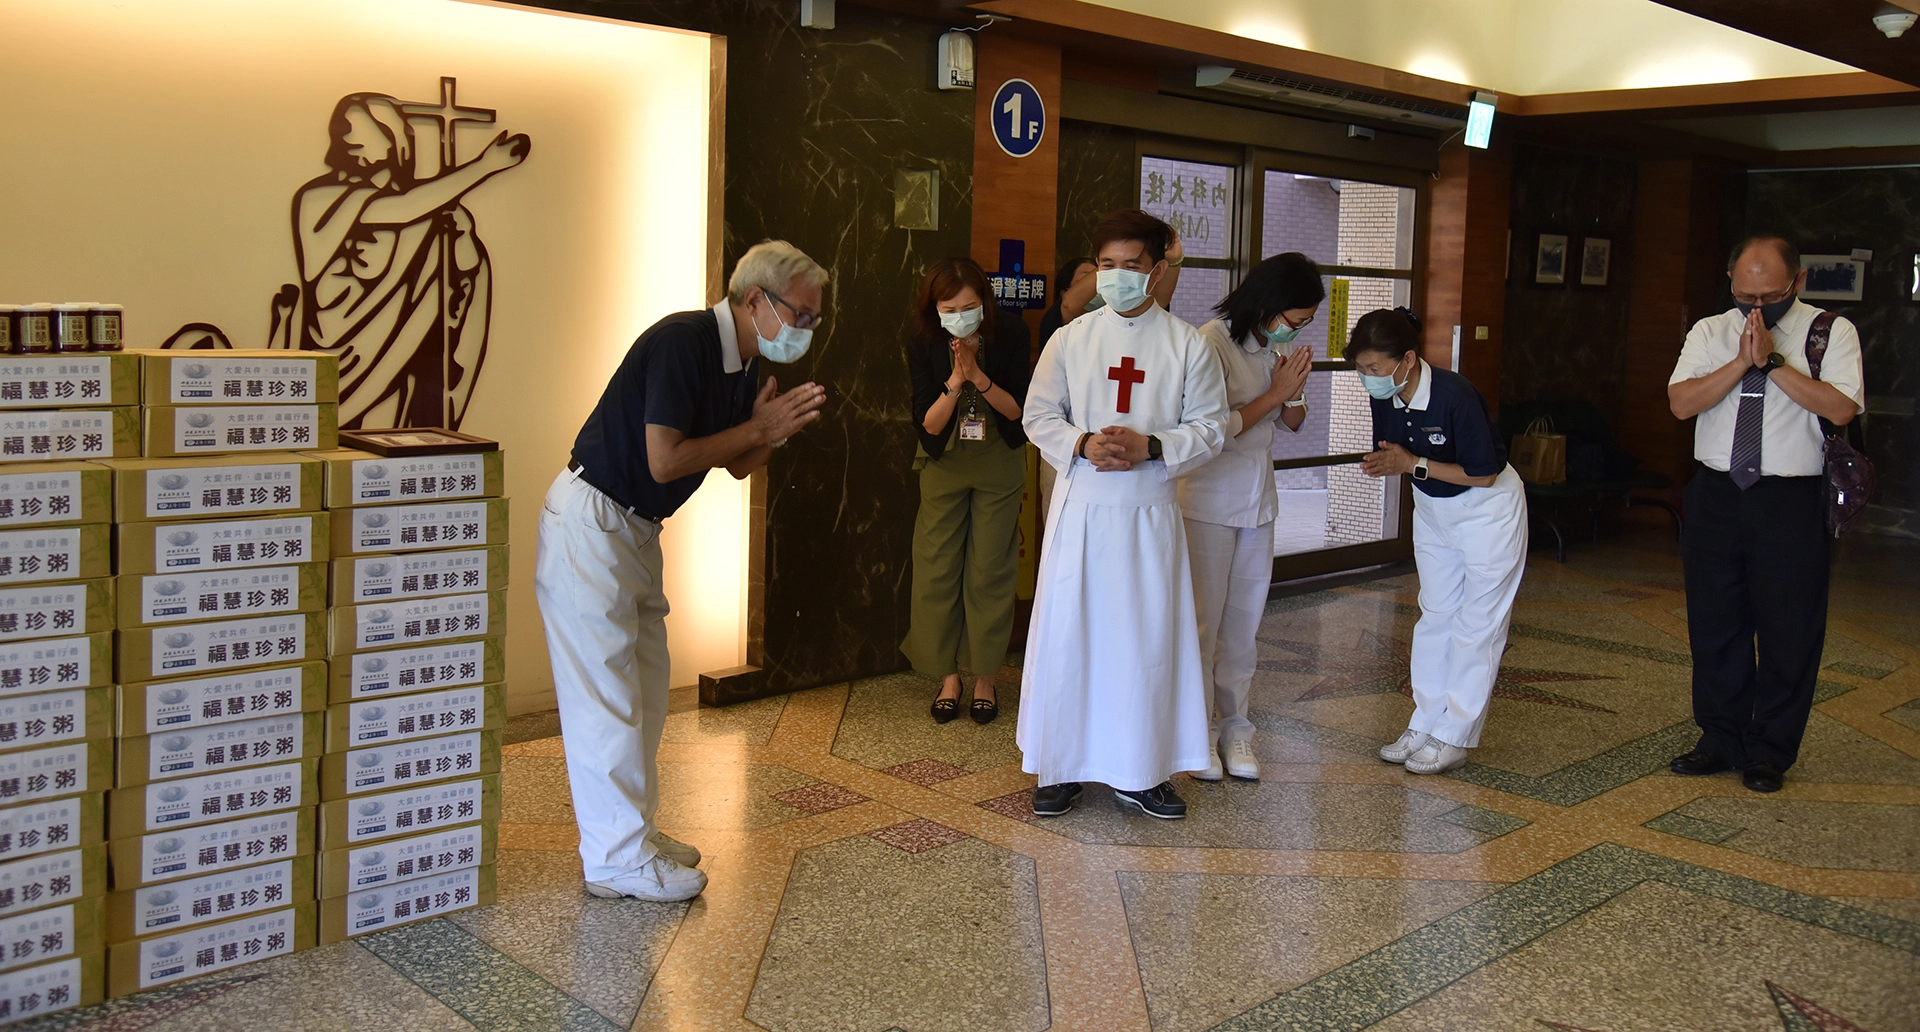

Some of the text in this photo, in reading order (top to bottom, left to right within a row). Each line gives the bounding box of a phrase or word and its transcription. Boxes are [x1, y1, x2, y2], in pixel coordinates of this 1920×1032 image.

[988, 277, 1044, 299] 滑警告牌
[1002, 299, 1015, 307] floor
[1016, 300, 1027, 308] sign
[1, 380, 100, 399] 福慧珍粥
[223, 380, 306, 396] 福慧珍粥
[3, 434, 102, 454] 福慧珍粥
[226, 426, 309, 444] 福慧珍粥
[202, 485, 290, 506] 福慧珍粥
[400, 474, 476, 494] 福慧珍粥
[401, 523, 478, 543] 福慧珍粥
[212, 539, 301, 562] 福慧珍粥
[402, 570, 478, 591] 福慧珍粥
[198, 588, 288, 611] 福慧珍粥
[0, 609, 74, 632] 慧珍粥
[404, 614, 479, 637] 福慧珍粥
[208, 637, 295, 662] 福慧珍粥
[1, 662, 78, 687] 慧珍粥
[399, 662, 475, 685] 福慧珍粥
[203, 690, 291, 718] 福慧珍粥
[0, 714, 73, 741] 慧珍粥
[398, 708, 475, 733] 福慧珍粥
[206, 736, 293, 764] 福慧珍粥
[394, 752, 471, 779] 福慧珍粥
[0, 768, 75, 797] 慧珍粥
[202, 786, 291, 814] 福慧珍粥
[396, 800, 473, 827] 福慧珍粥
[198, 834, 287, 865] 福慧珍粥
[396, 847, 473, 876] 福慧珍粥
[192, 883, 282, 916] 福慧珍粥
[394, 886, 470, 918] 福慧珍粥
[0, 932, 62, 961] 珍粥
[196, 932, 285, 967] 福慧珍粥
